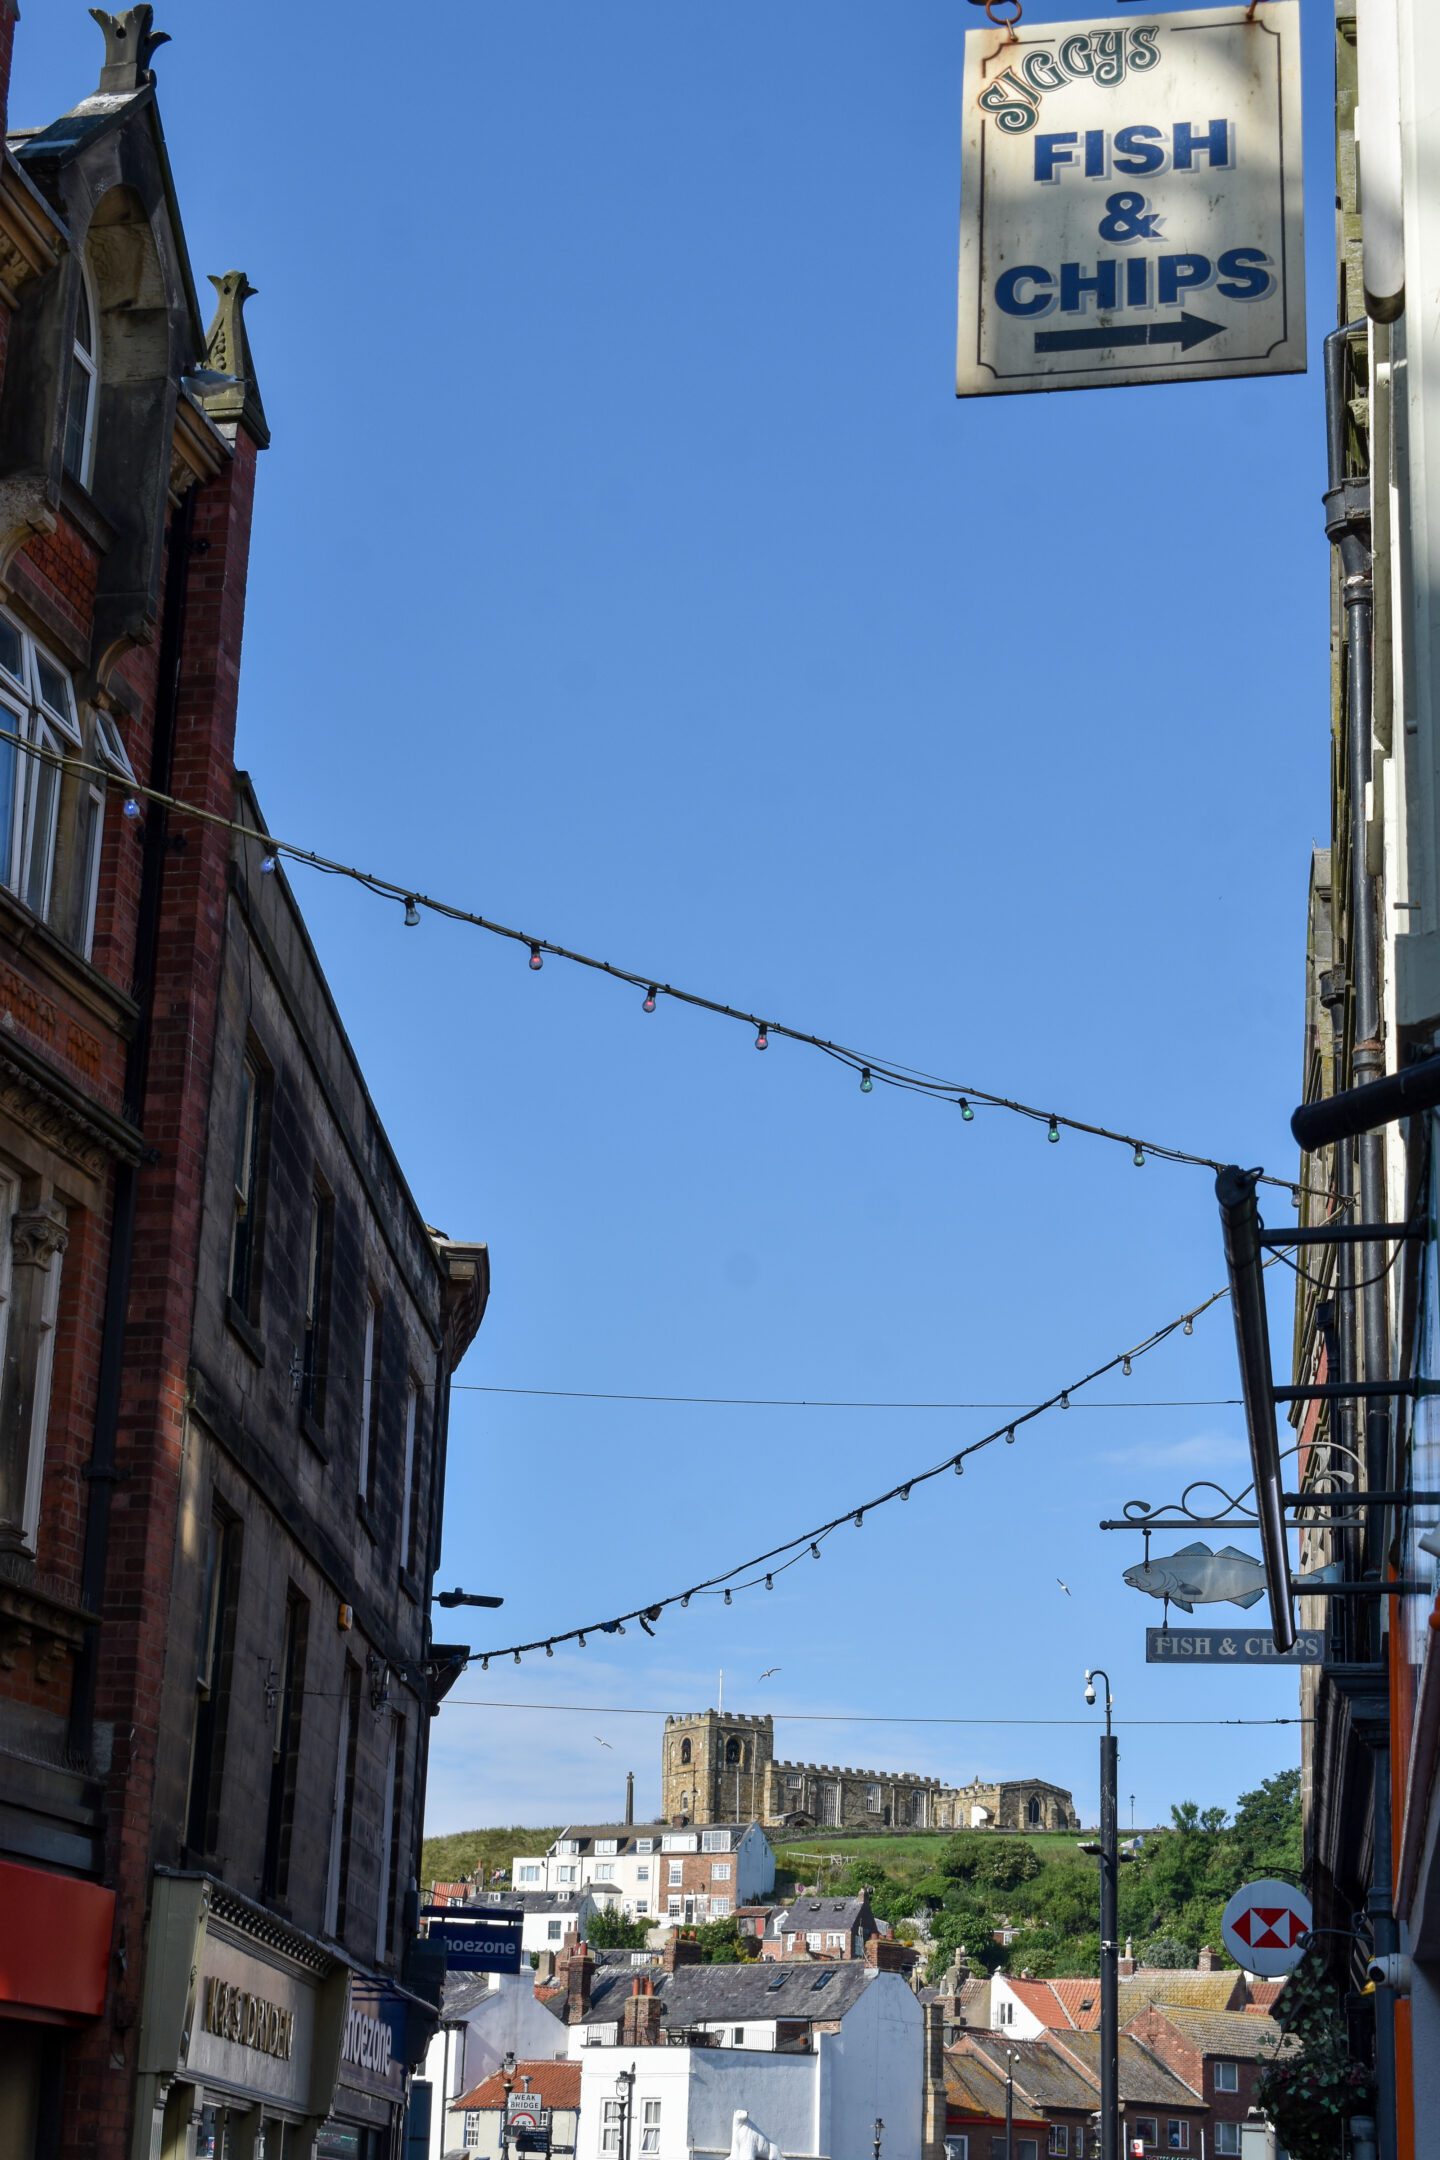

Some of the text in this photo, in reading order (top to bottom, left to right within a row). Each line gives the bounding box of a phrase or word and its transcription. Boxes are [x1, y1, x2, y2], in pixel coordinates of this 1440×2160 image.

[1034, 119, 1235, 185] FISH
[1098, 191, 1168, 245] &
[994, 248, 1276, 320] CHIPS
[1154, 1637, 1318, 1656] FISH & CHPS
[442, 1935, 516, 1955] hoezone
[244, 1993, 295, 2061] DRYDEN
[510, 2101, 539, 2109] BRIDGE
